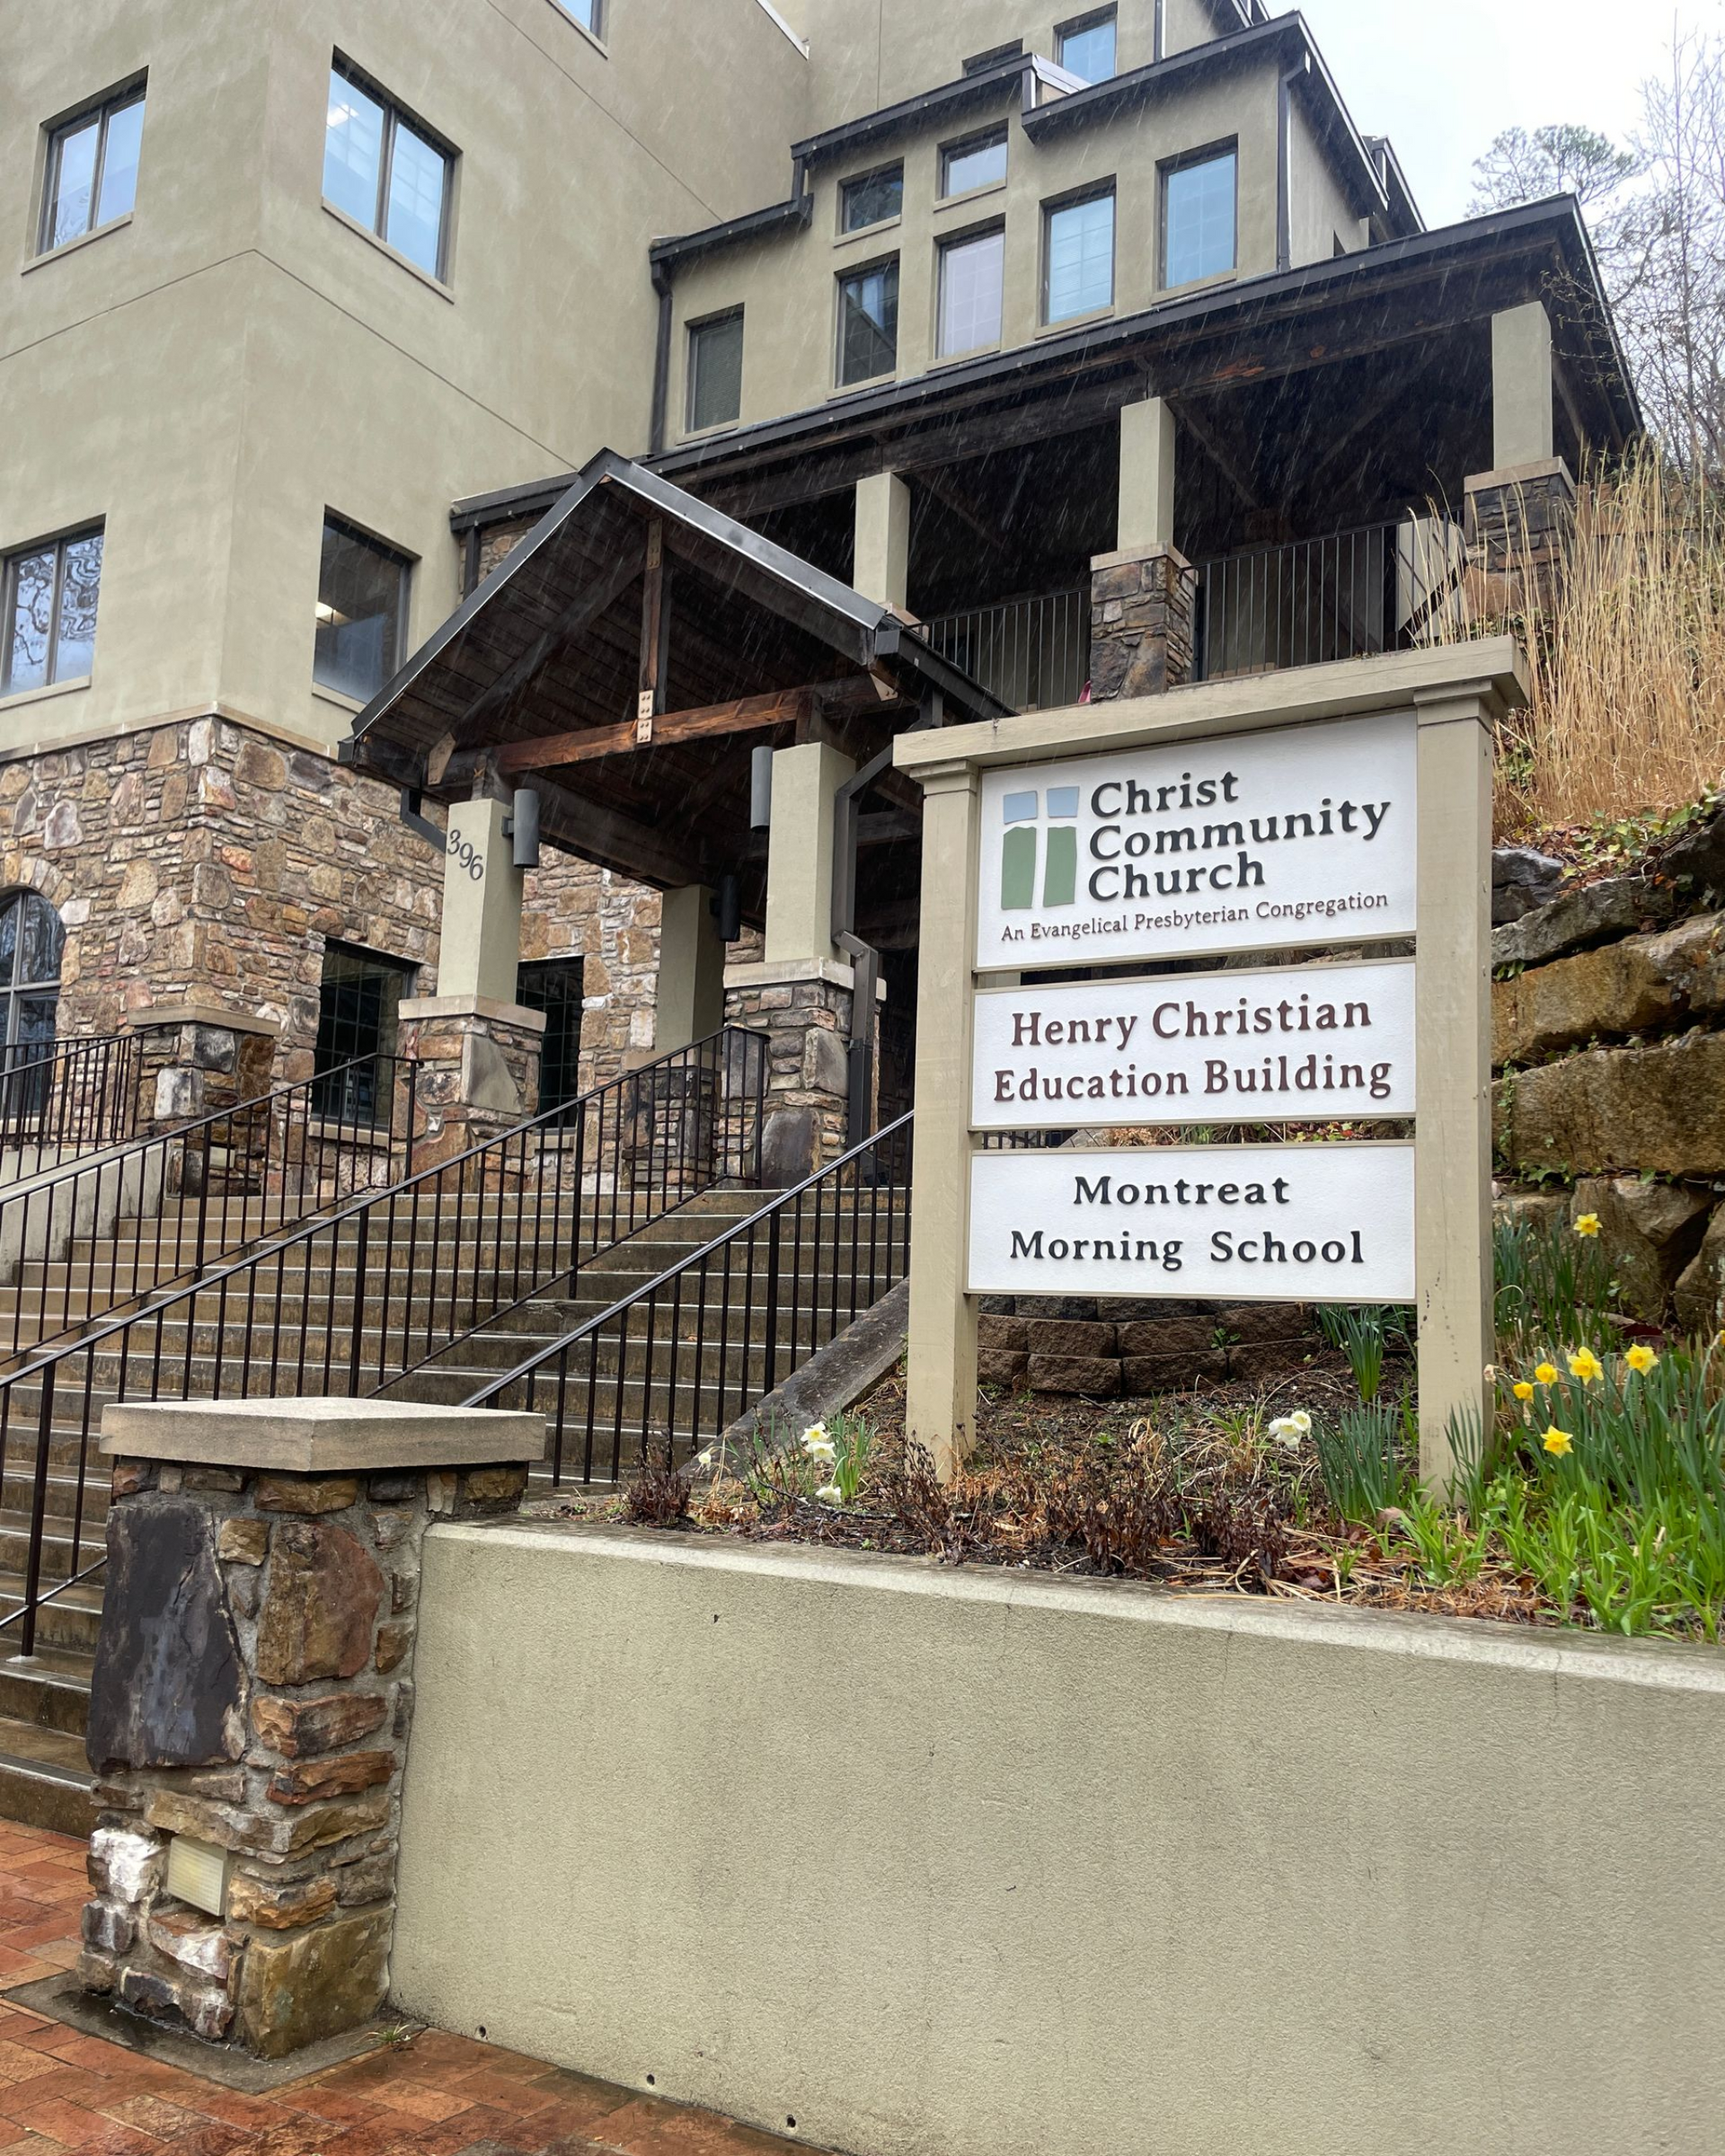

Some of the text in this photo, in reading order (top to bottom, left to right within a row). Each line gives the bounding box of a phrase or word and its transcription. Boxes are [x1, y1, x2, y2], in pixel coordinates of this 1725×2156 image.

[1090, 772, 1239, 818] Christ
[1089, 798, 1392, 861] Community
[447, 829, 484, 880] 396
[1088, 851, 1266, 900] Church
[1001, 891, 1389, 942] An Evangelical Presbyterian Congregation
[1011, 994, 1372, 1051] Henry Christian
[994, 1054, 1393, 1101] Education Building
[1074, 1175, 1291, 1206] Montreat
[1010, 1230, 1365, 1272] Morning School
